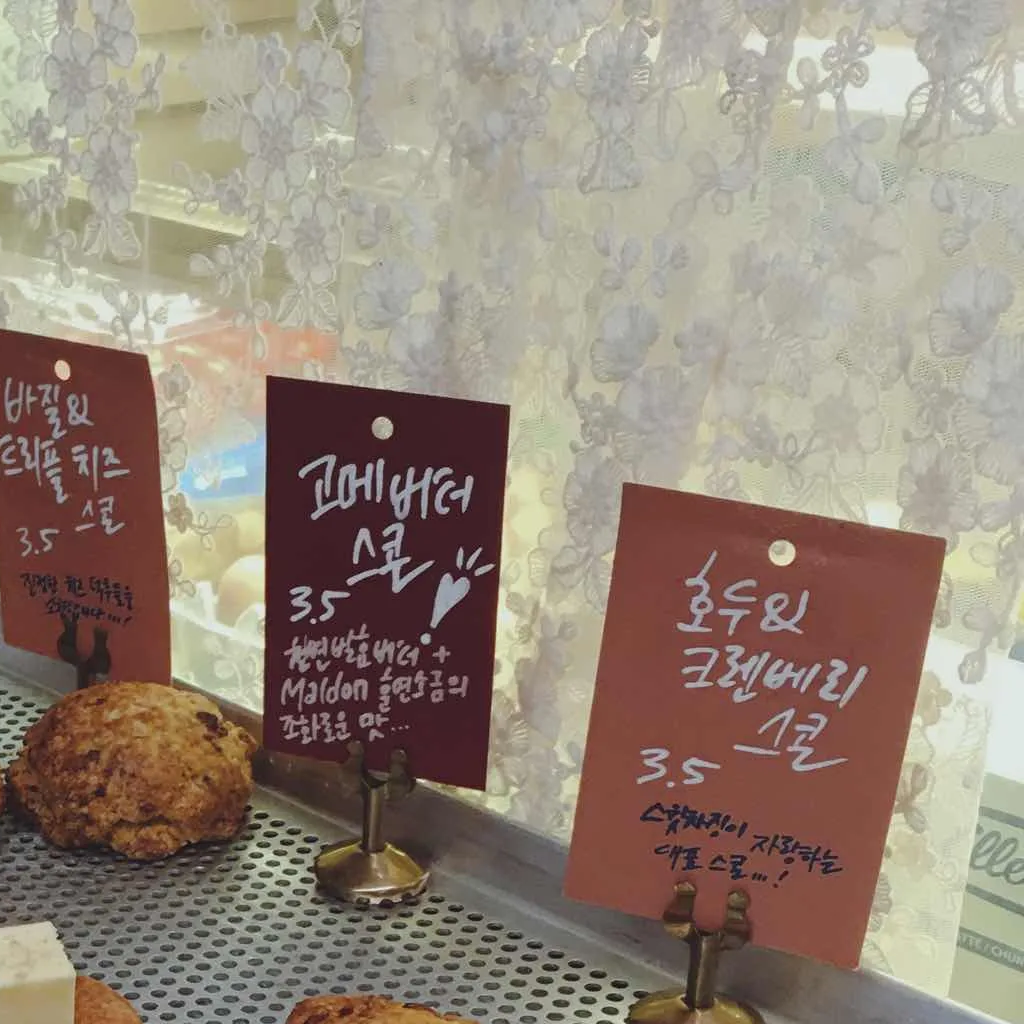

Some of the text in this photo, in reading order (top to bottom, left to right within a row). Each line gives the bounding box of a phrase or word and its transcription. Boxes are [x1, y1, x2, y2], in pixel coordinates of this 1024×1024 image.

[71, 444, 131, 491] 치즈
[74, 496, 126, 535] 스콘
[15, 526, 60, 557] 3.5
[346, 522, 435, 593] 스콘
[289, 586, 352, 624] 3.5
[432, 645, 451, 664] +
[280, 671, 369, 713] Maldon
[733, 708, 849, 772] 스콘
[636, 747, 721, 788] 3.5
[749, 833, 843, 874] 자랑하는
